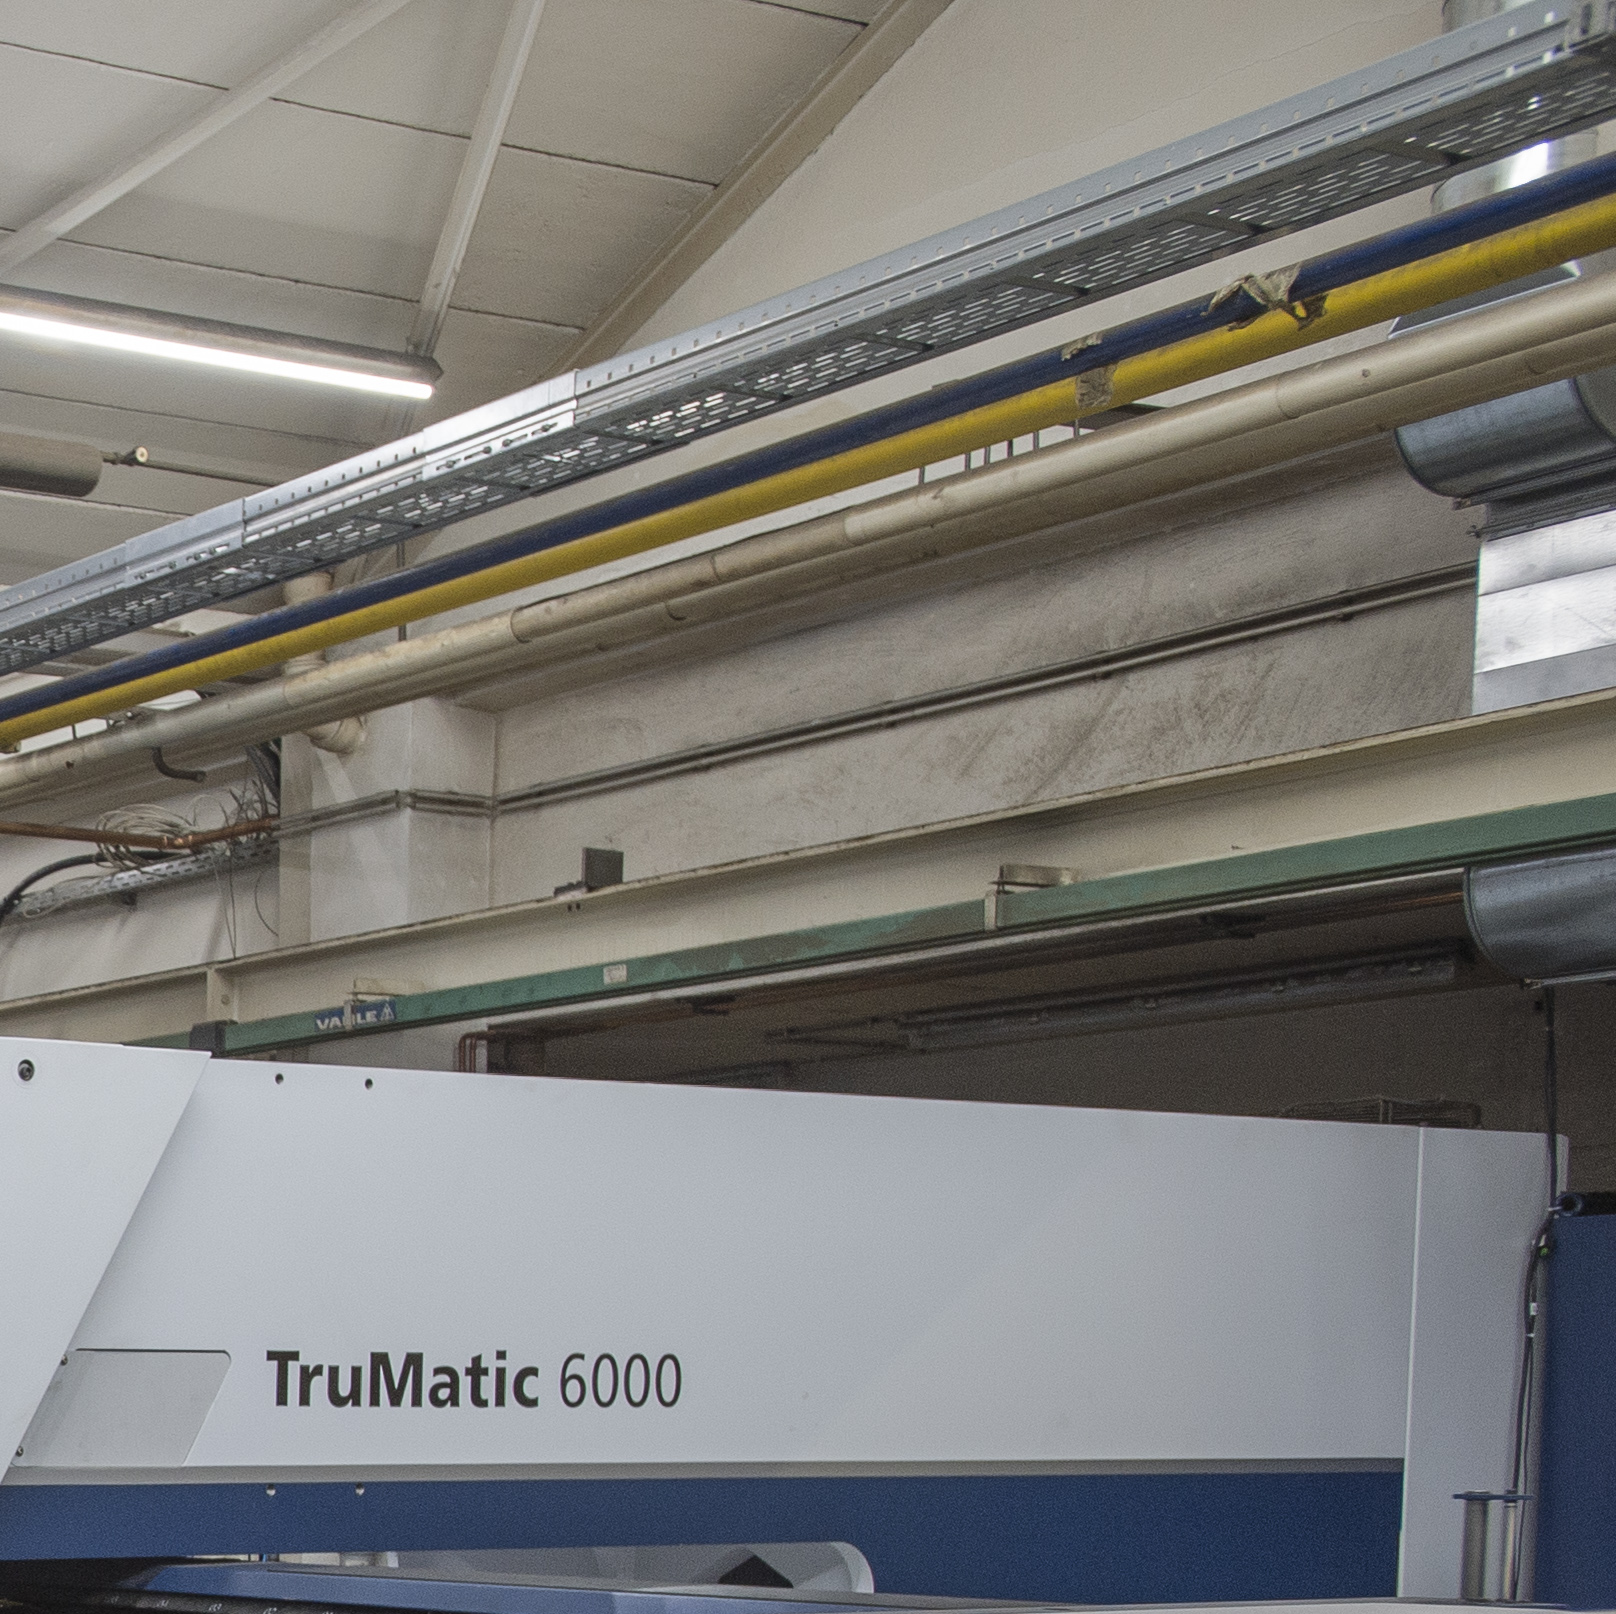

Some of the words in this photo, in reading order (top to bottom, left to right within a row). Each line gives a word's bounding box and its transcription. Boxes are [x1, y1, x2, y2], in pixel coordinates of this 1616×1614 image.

[316, 1009, 378, 1030] VALE
[266, 1349, 539, 1408] TruMatic
[559, 1352, 683, 1408] 6000
